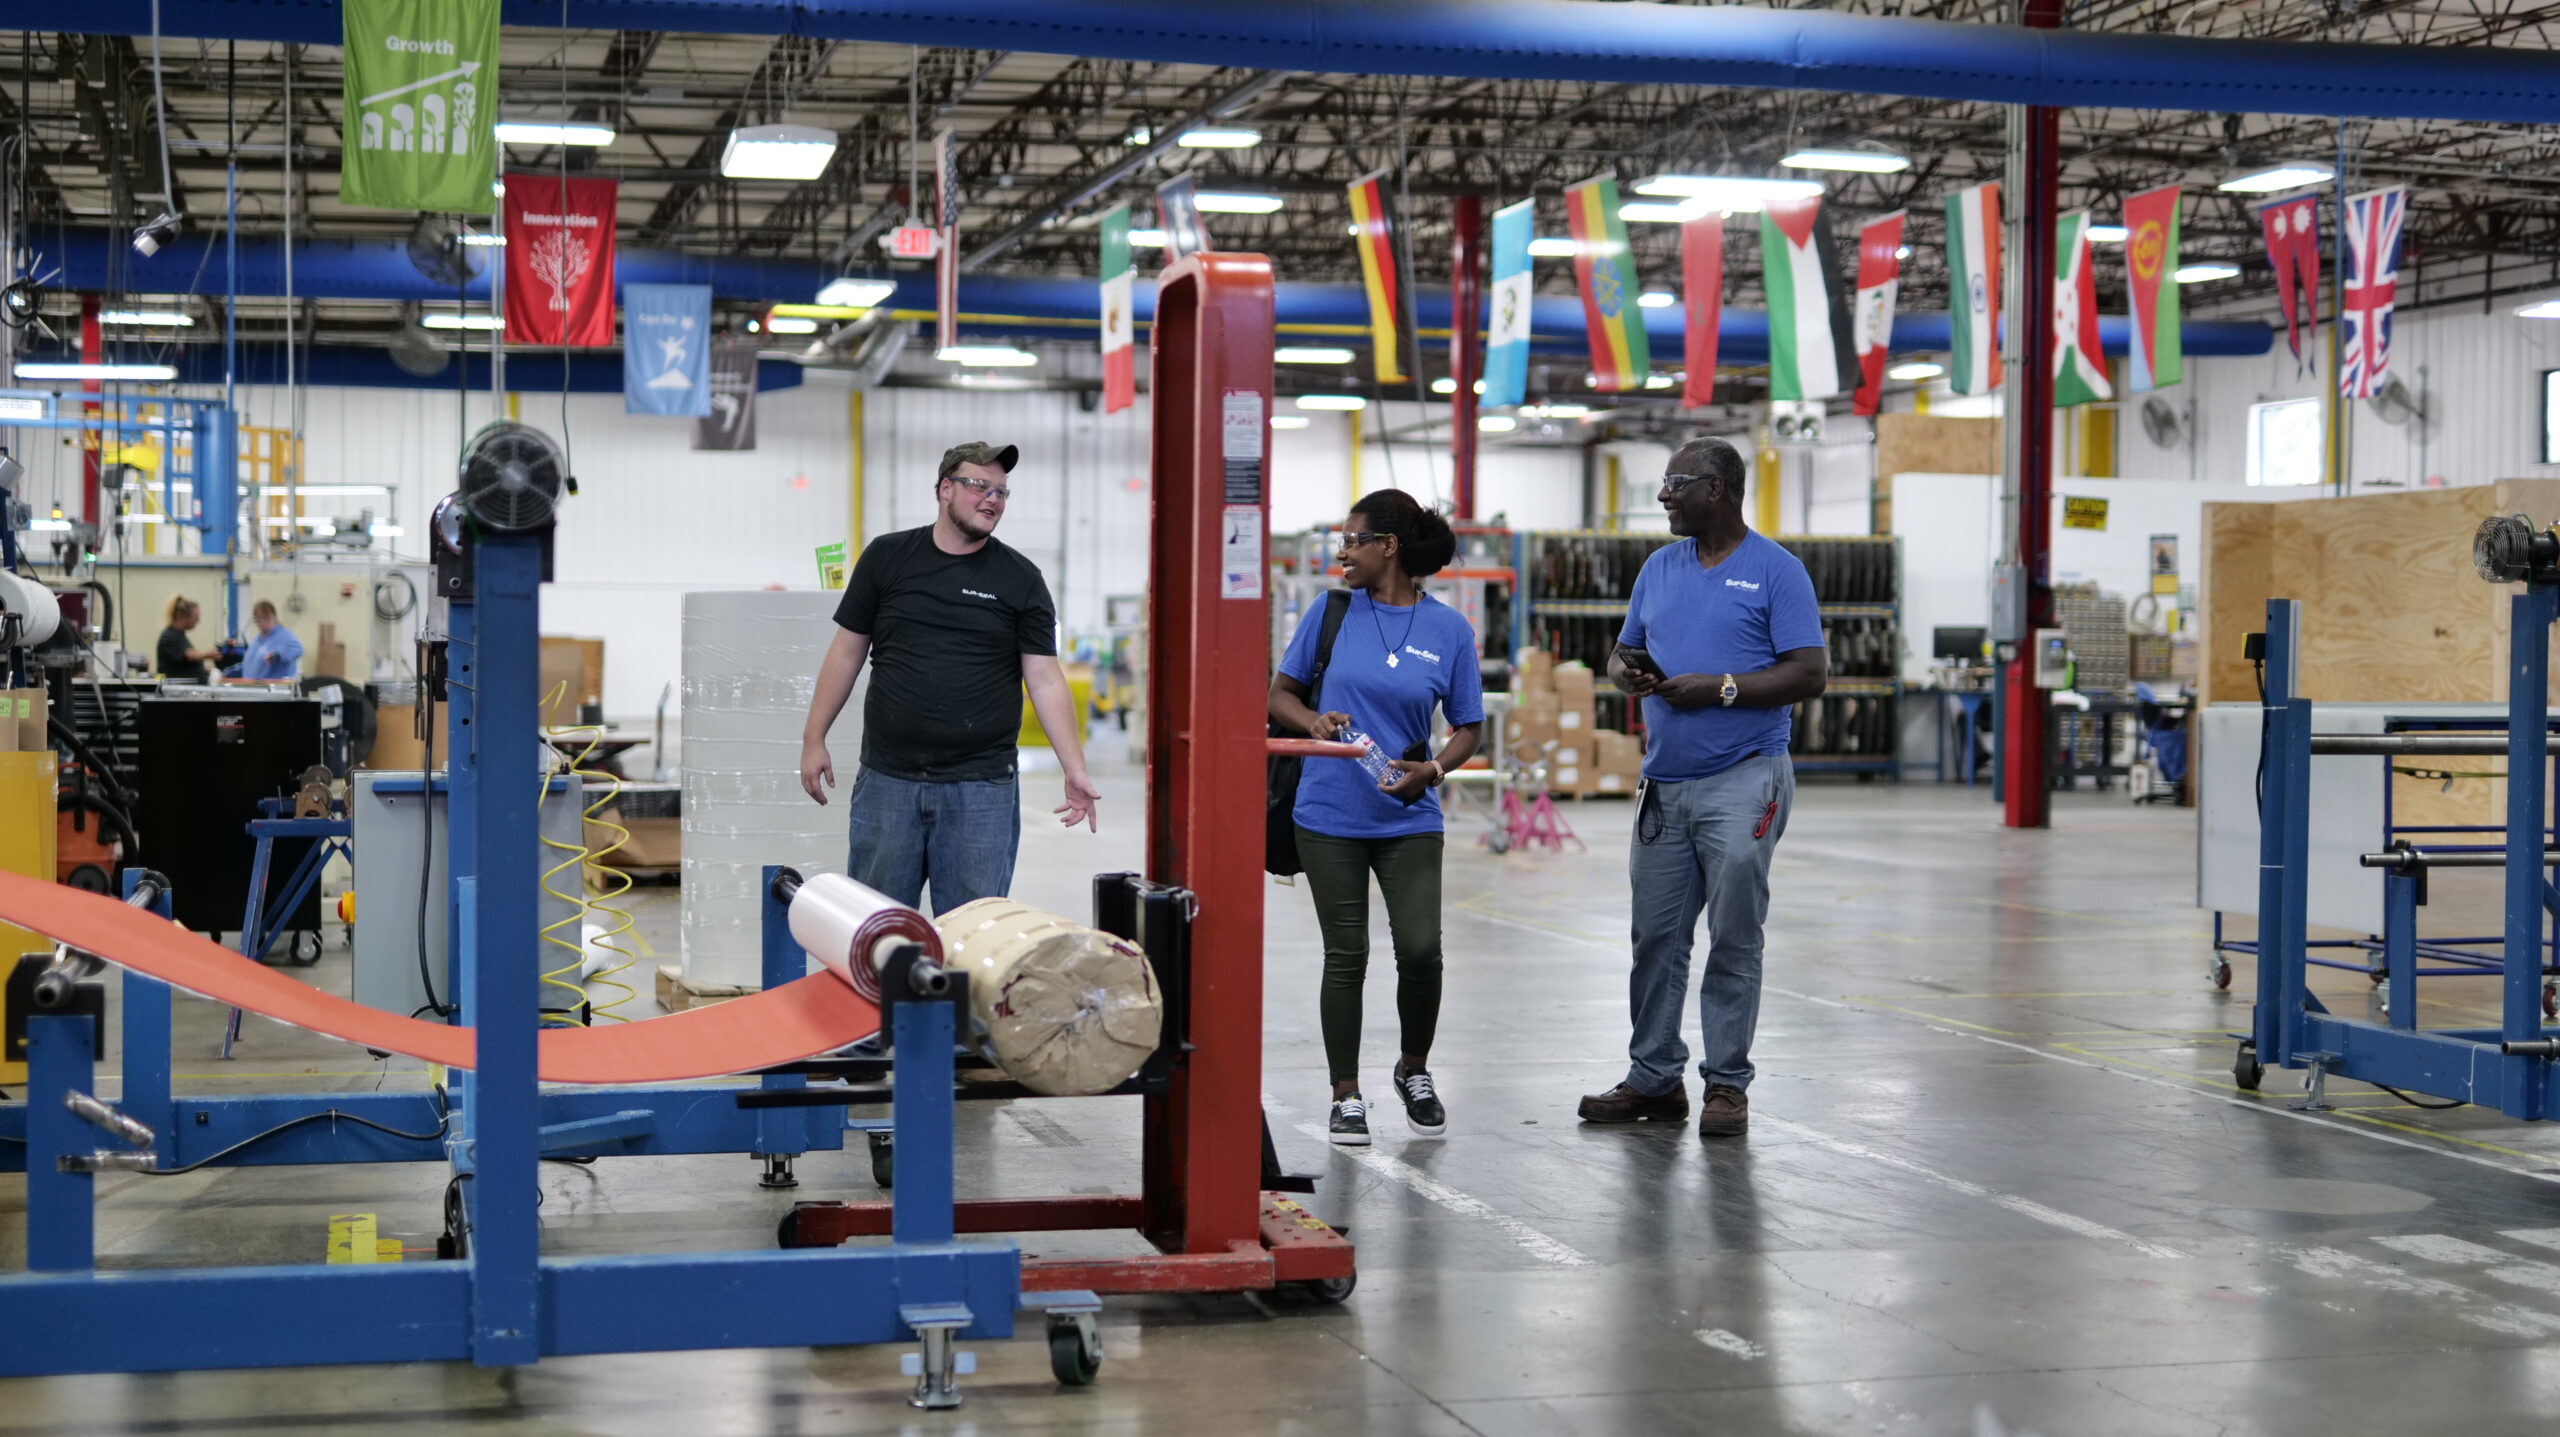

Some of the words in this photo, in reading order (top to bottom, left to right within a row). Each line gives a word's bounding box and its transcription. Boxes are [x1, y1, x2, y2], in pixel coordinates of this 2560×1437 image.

[385, 35, 455, 56] Growth
[899, 228, 932, 254] EXIT
[1725, 579, 1760, 590] Sur-Seal
[962, 588, 998, 601] SUR-SEAL
[1405, 645, 1440, 663] Sur-Seal
